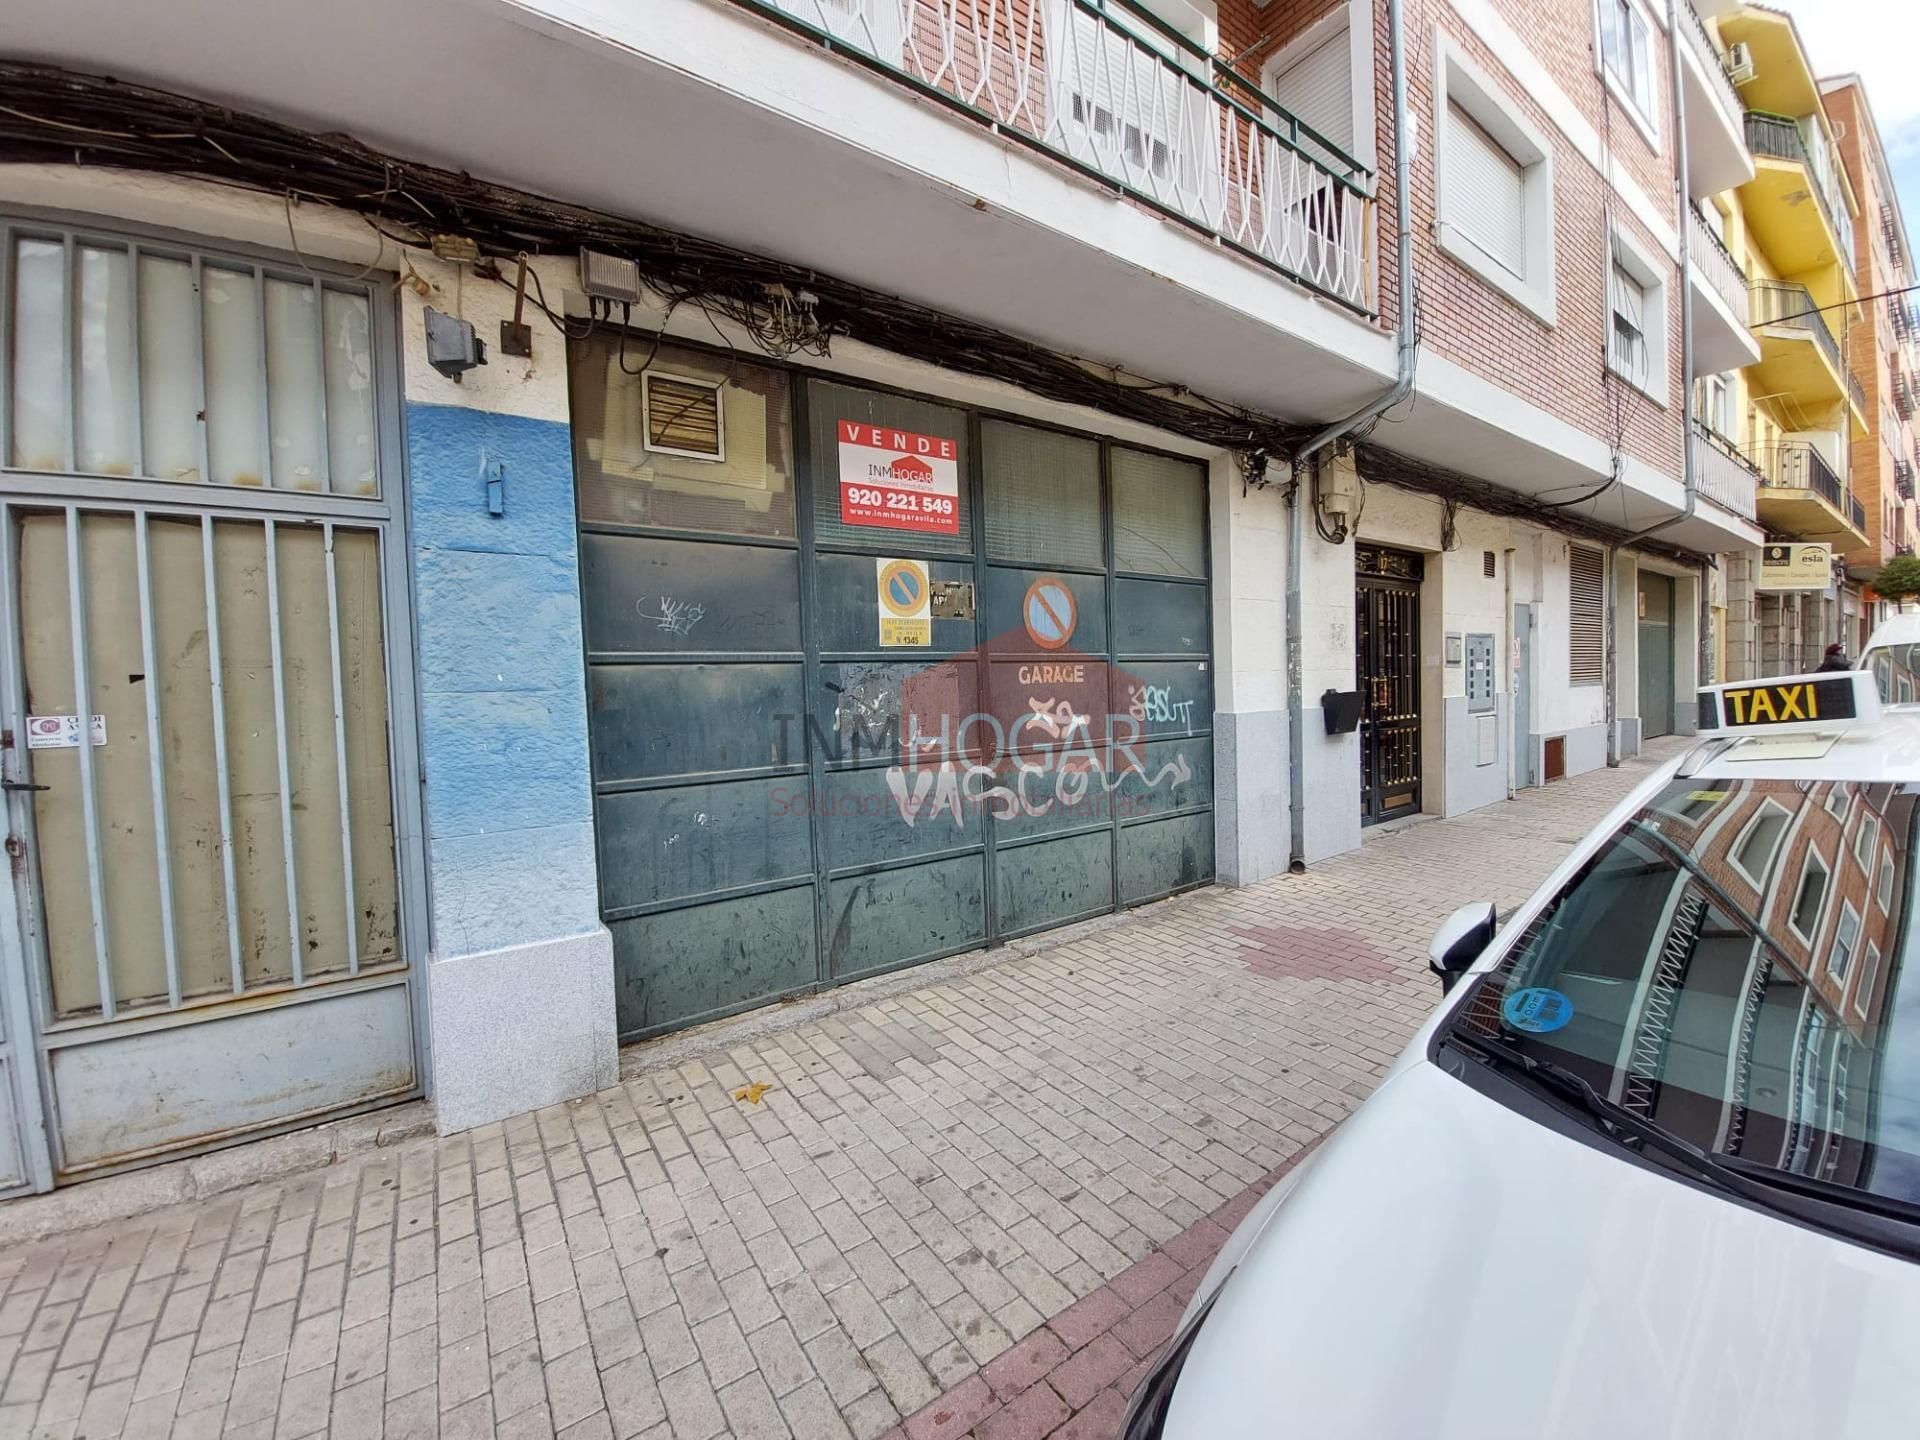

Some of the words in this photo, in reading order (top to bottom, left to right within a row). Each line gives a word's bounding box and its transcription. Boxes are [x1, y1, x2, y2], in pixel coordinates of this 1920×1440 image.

[846, 424, 950, 457] VENDE
[868, 463, 933, 484] INMHOGAR
[848, 487, 882, 506] 920
[886, 492, 919, 511] 221
[922, 496, 952, 515] 549
[849, 508, 953, 525] www.inmhogaravila.com
[1018, 665, 1085, 684] GARAGE
[1724, 684, 1818, 724] TAXI
